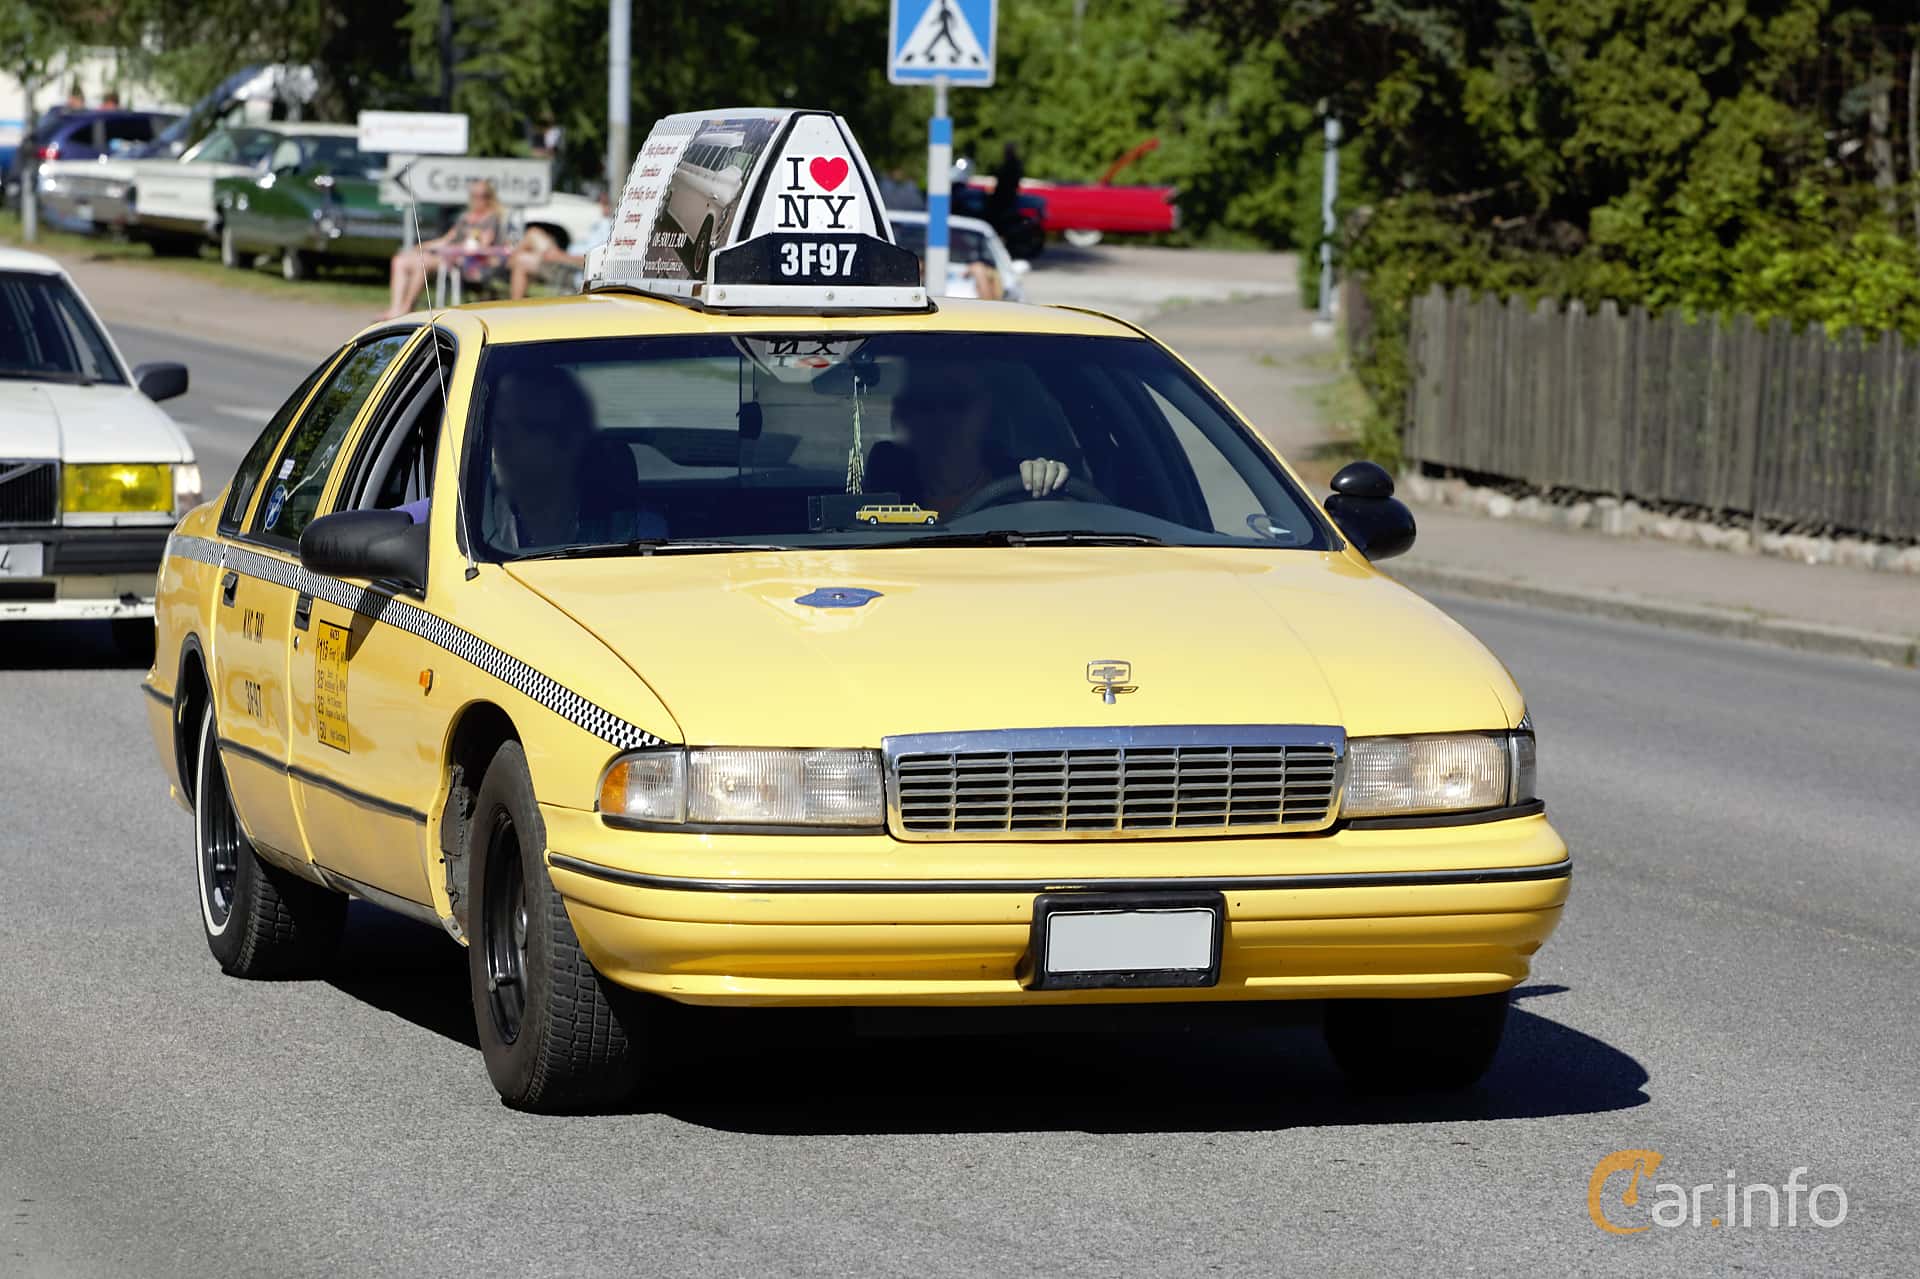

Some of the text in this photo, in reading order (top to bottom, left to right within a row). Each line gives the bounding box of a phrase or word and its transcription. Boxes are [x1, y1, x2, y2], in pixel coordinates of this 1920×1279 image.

[786, 157, 805, 190] I
[778, 194, 856, 229] NY
[780, 242, 857, 276] 3F97
